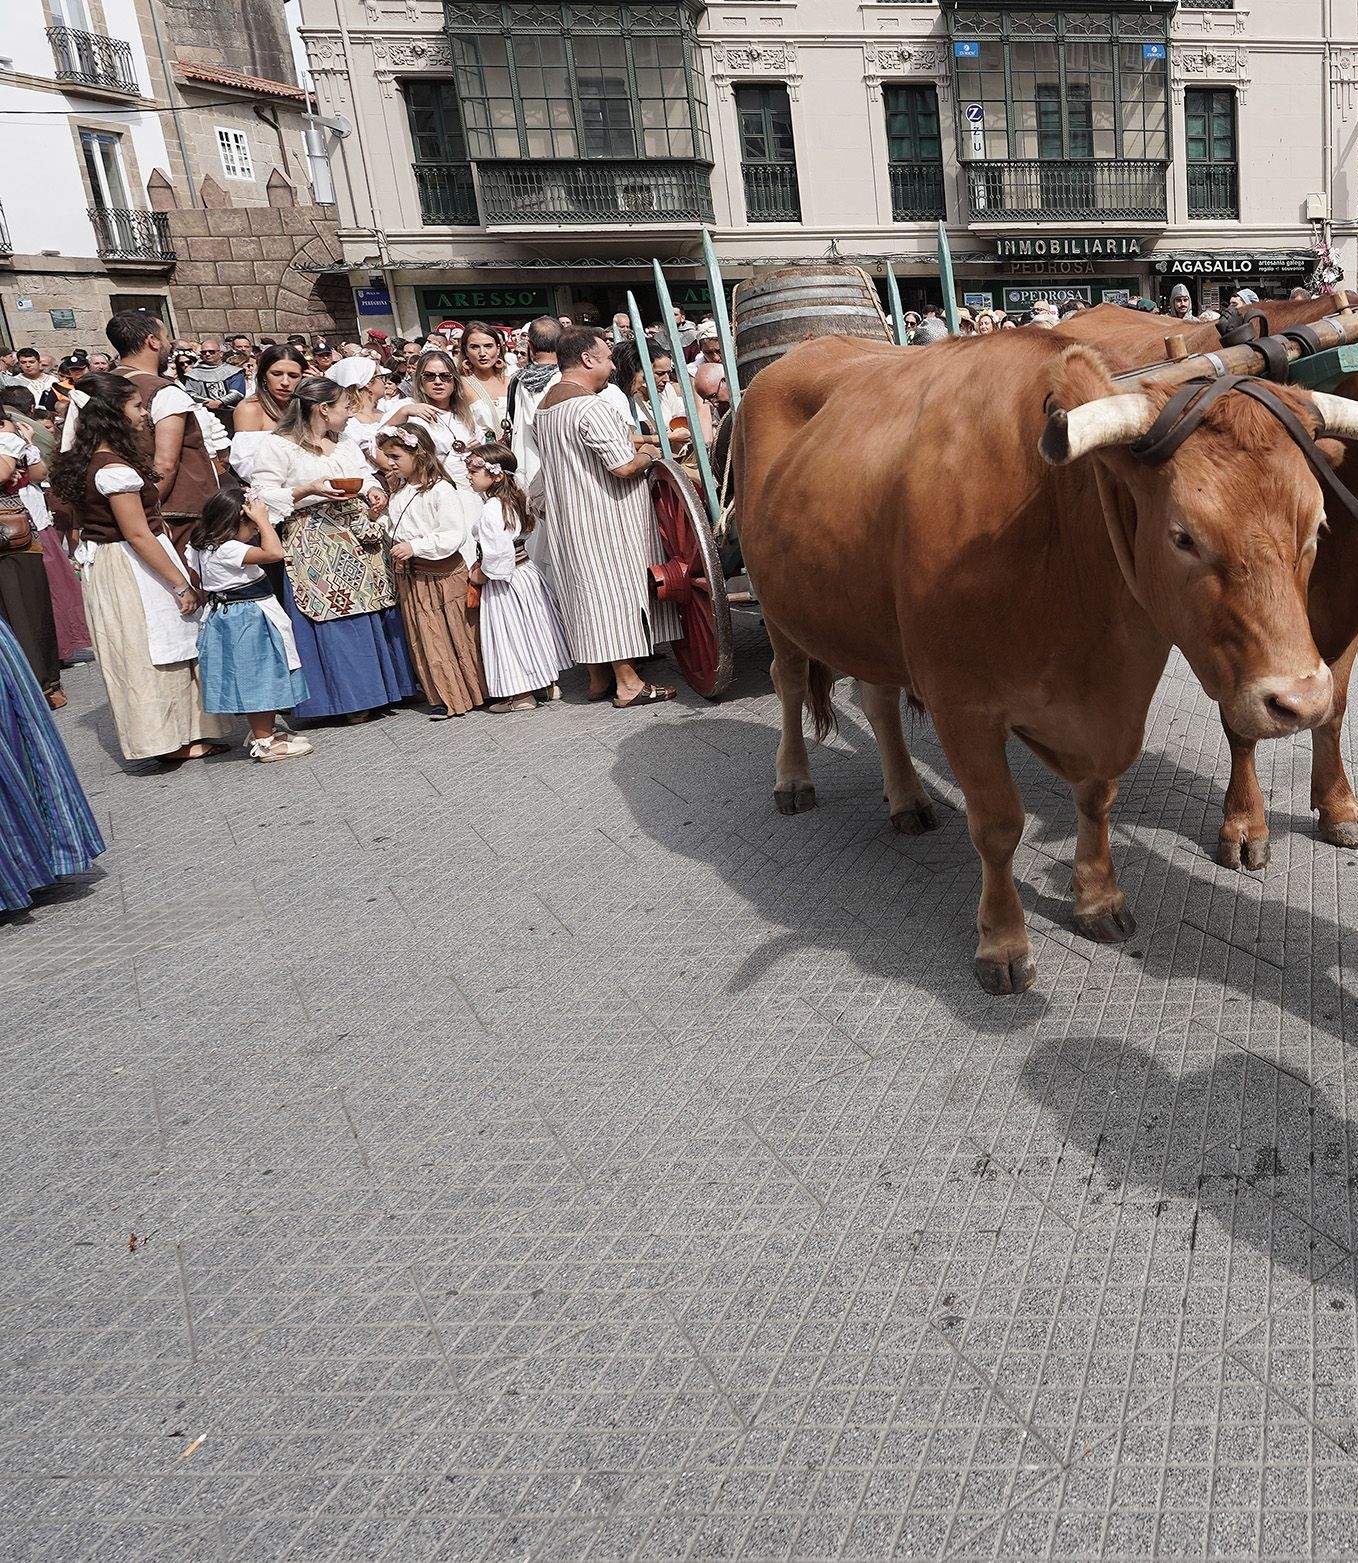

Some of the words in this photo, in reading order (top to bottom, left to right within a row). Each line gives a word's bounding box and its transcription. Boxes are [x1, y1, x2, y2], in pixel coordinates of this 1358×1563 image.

[997, 239, 1141, 255] INMOBILIARIA
[1172, 260, 1252, 273] AGASALLO
[438, 292, 533, 307] ARESSO
[1020, 290, 1083, 301] PEDROSA
